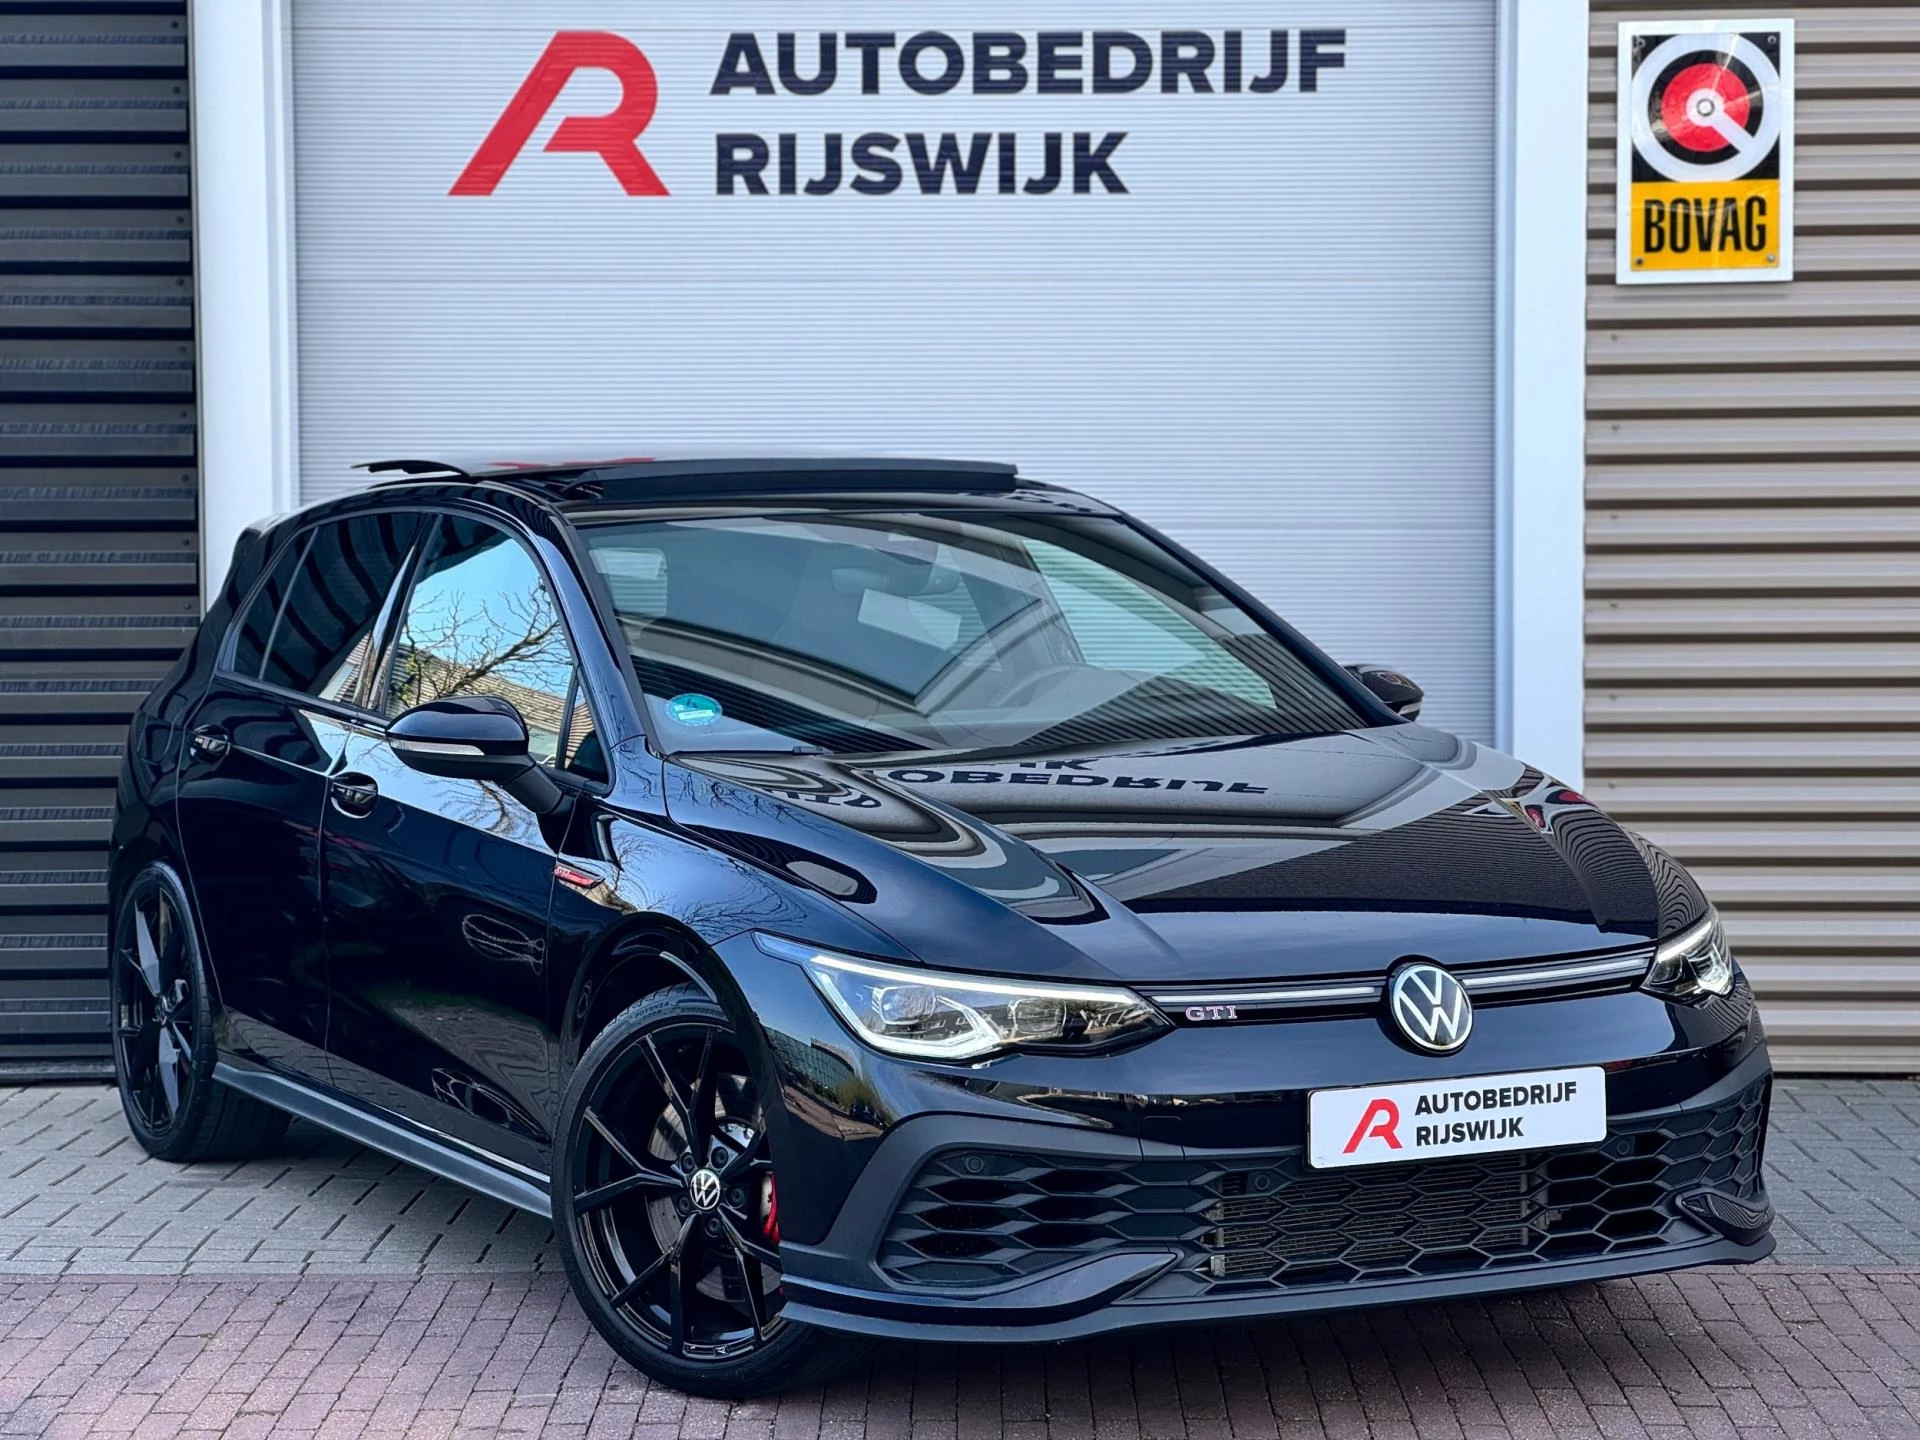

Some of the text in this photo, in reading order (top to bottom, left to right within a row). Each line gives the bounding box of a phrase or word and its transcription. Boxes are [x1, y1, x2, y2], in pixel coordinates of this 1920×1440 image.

[710, 29, 1346, 95] AUTOBEDRIJF
[716, 132, 1129, 195] RIJSWIJK
[1643, 195, 1767, 253] BOVAG
[1185, 1005, 1238, 1021] GTI
[1415, 1081, 1577, 1116] AUTOBEDRIJF
[1416, 1117, 1525, 1146] RIJSWIJK
